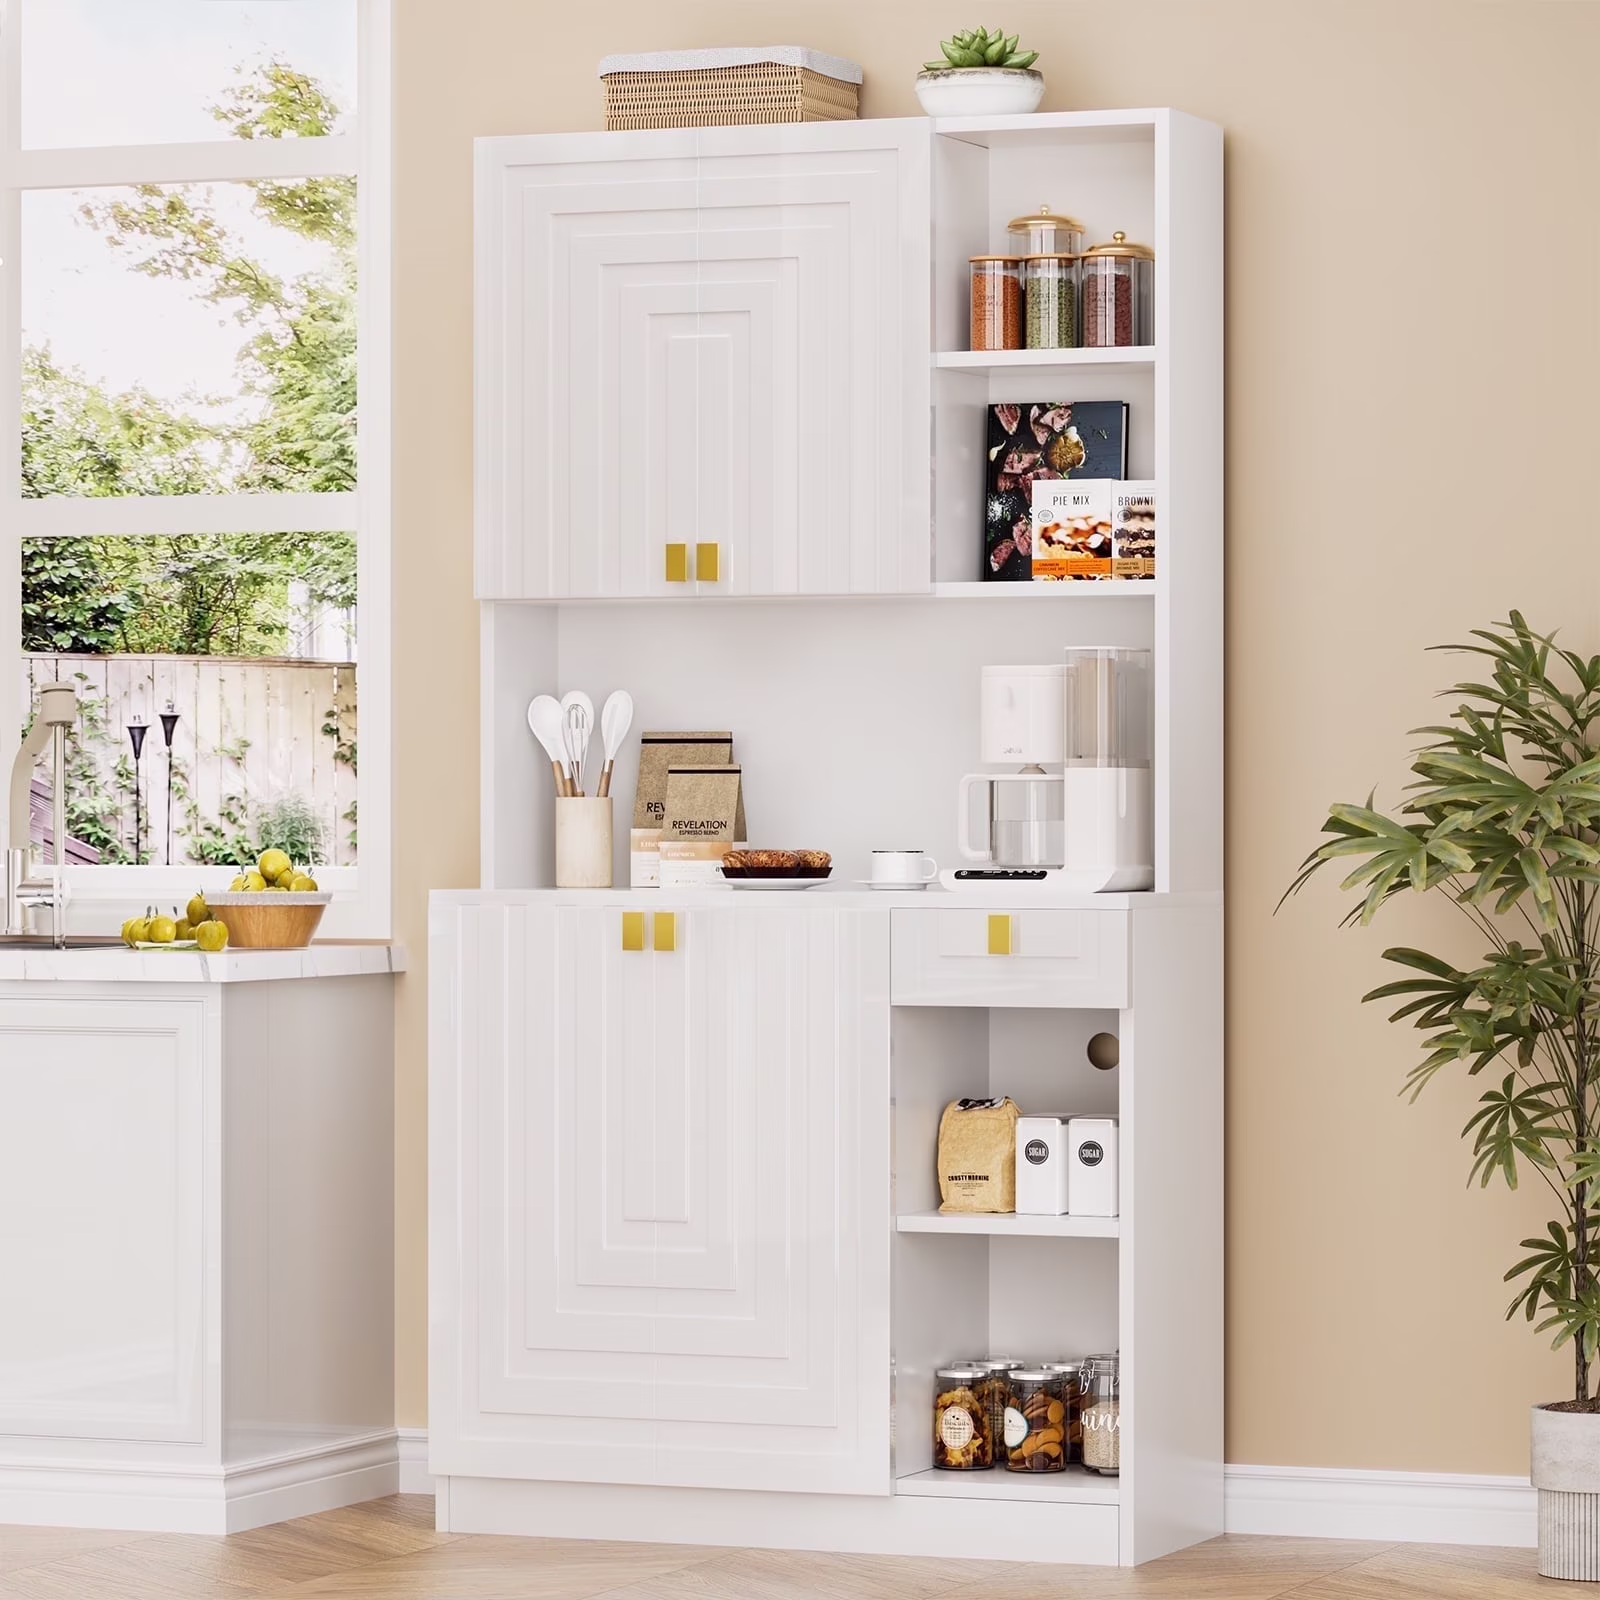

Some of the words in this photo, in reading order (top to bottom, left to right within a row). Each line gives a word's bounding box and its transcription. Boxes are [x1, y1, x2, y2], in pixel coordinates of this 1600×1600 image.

[1052, 495, 1068, 506] PIE
[1072, 495, 1090, 505] MIX
[1117, 495, 1155, 506] BROWNI
[671, 820, 728, 829] REVELATION
[1028, 1147, 1046, 1157] SUGAR
[1081, 1148, 1100, 1158] SUGAR
